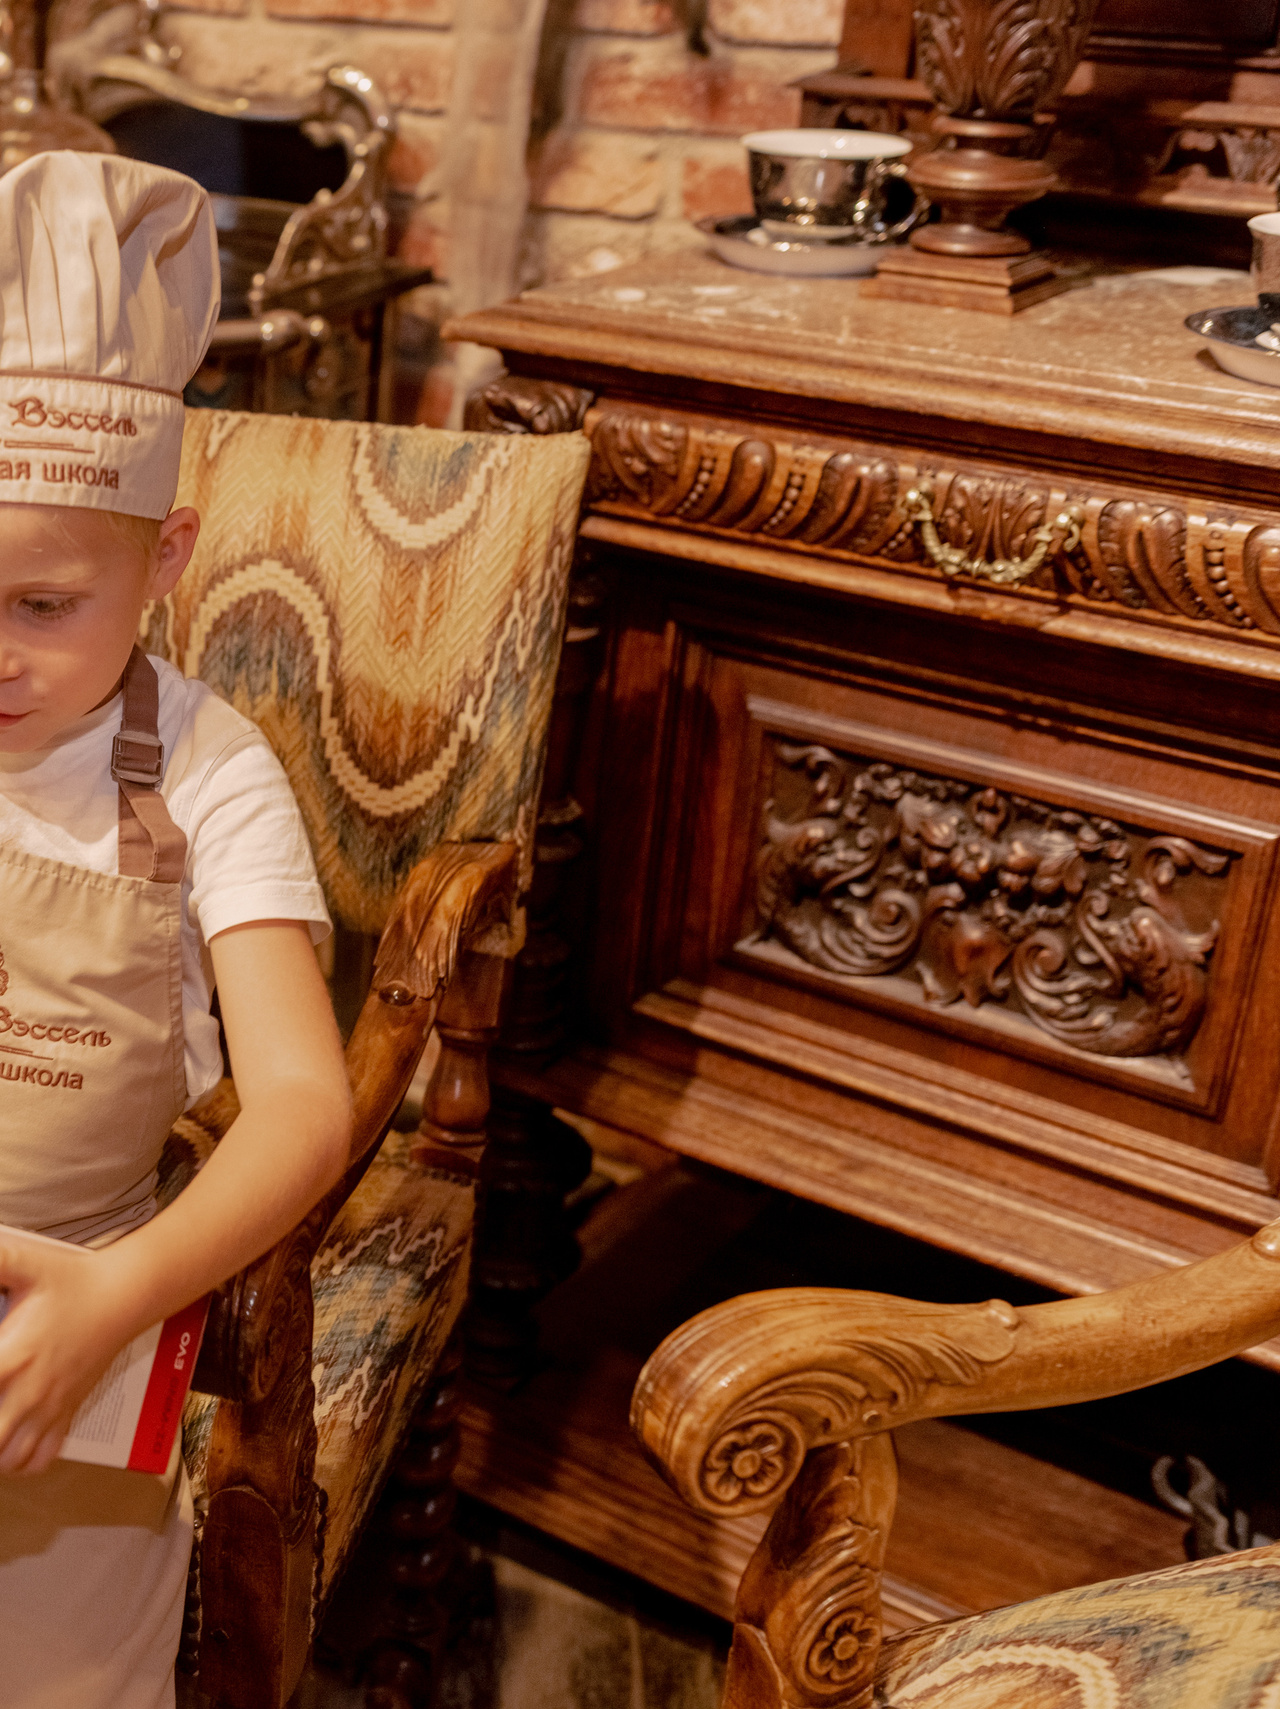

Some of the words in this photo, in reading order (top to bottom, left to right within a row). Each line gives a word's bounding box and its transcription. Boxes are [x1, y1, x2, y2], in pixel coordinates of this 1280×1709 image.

[8, 396, 139, 438] Вэссель
[43, 461, 120, 491] школа
[173, 1331, 192, 1371] EVO
